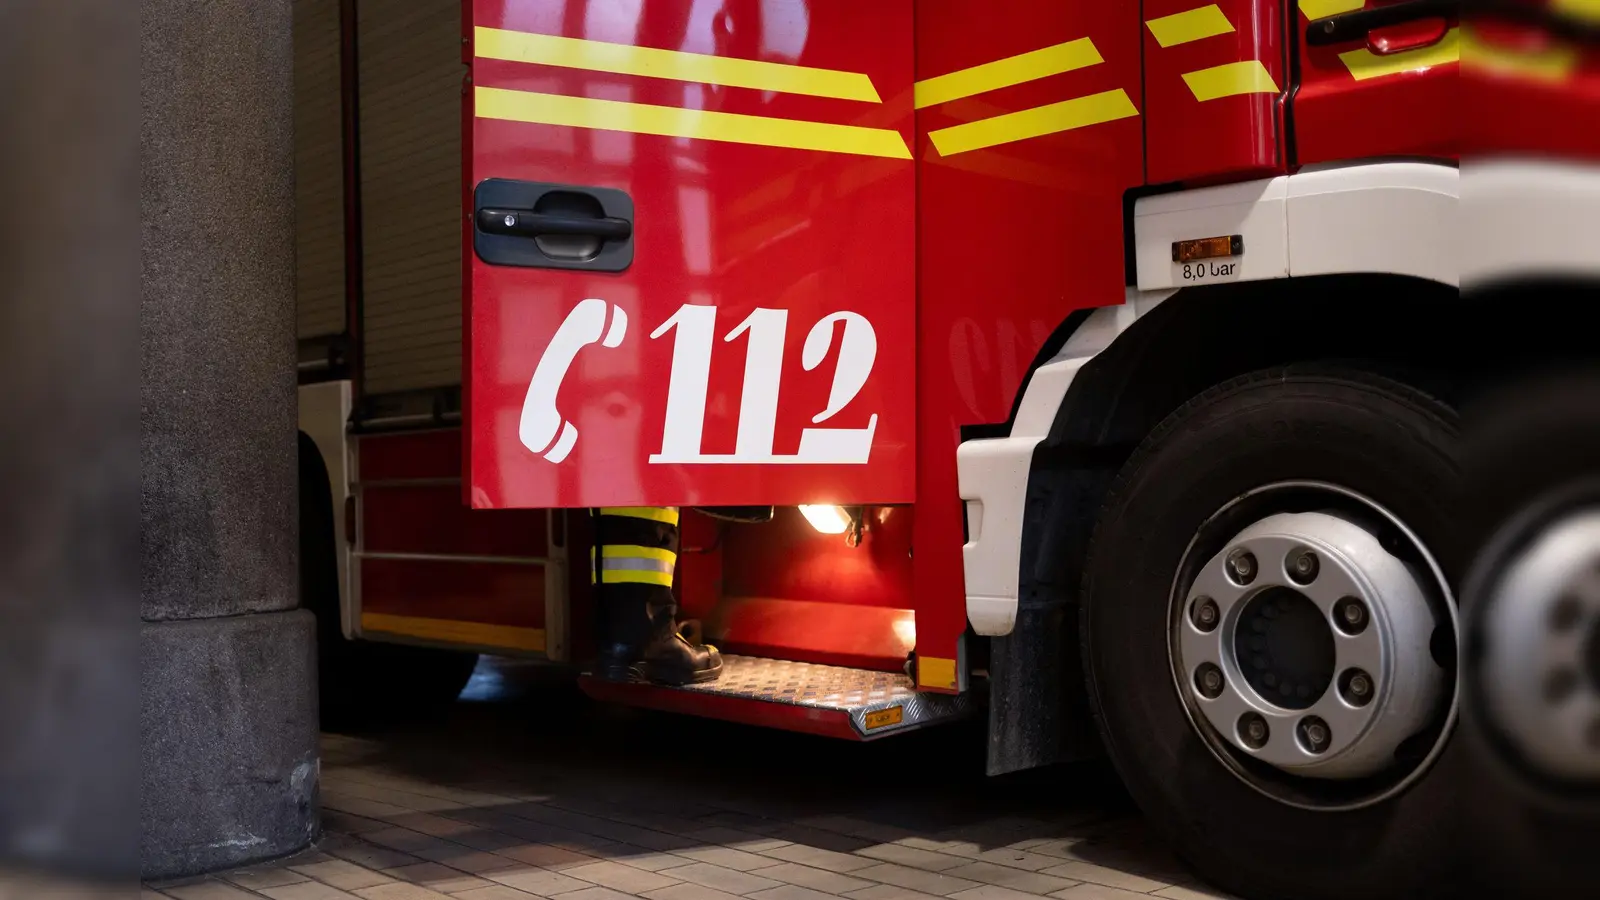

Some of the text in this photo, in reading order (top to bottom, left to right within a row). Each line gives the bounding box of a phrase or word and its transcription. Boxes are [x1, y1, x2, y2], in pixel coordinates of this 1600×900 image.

[1183, 262, 1236, 281] 8,0 bar
[648, 304, 878, 464] 112
